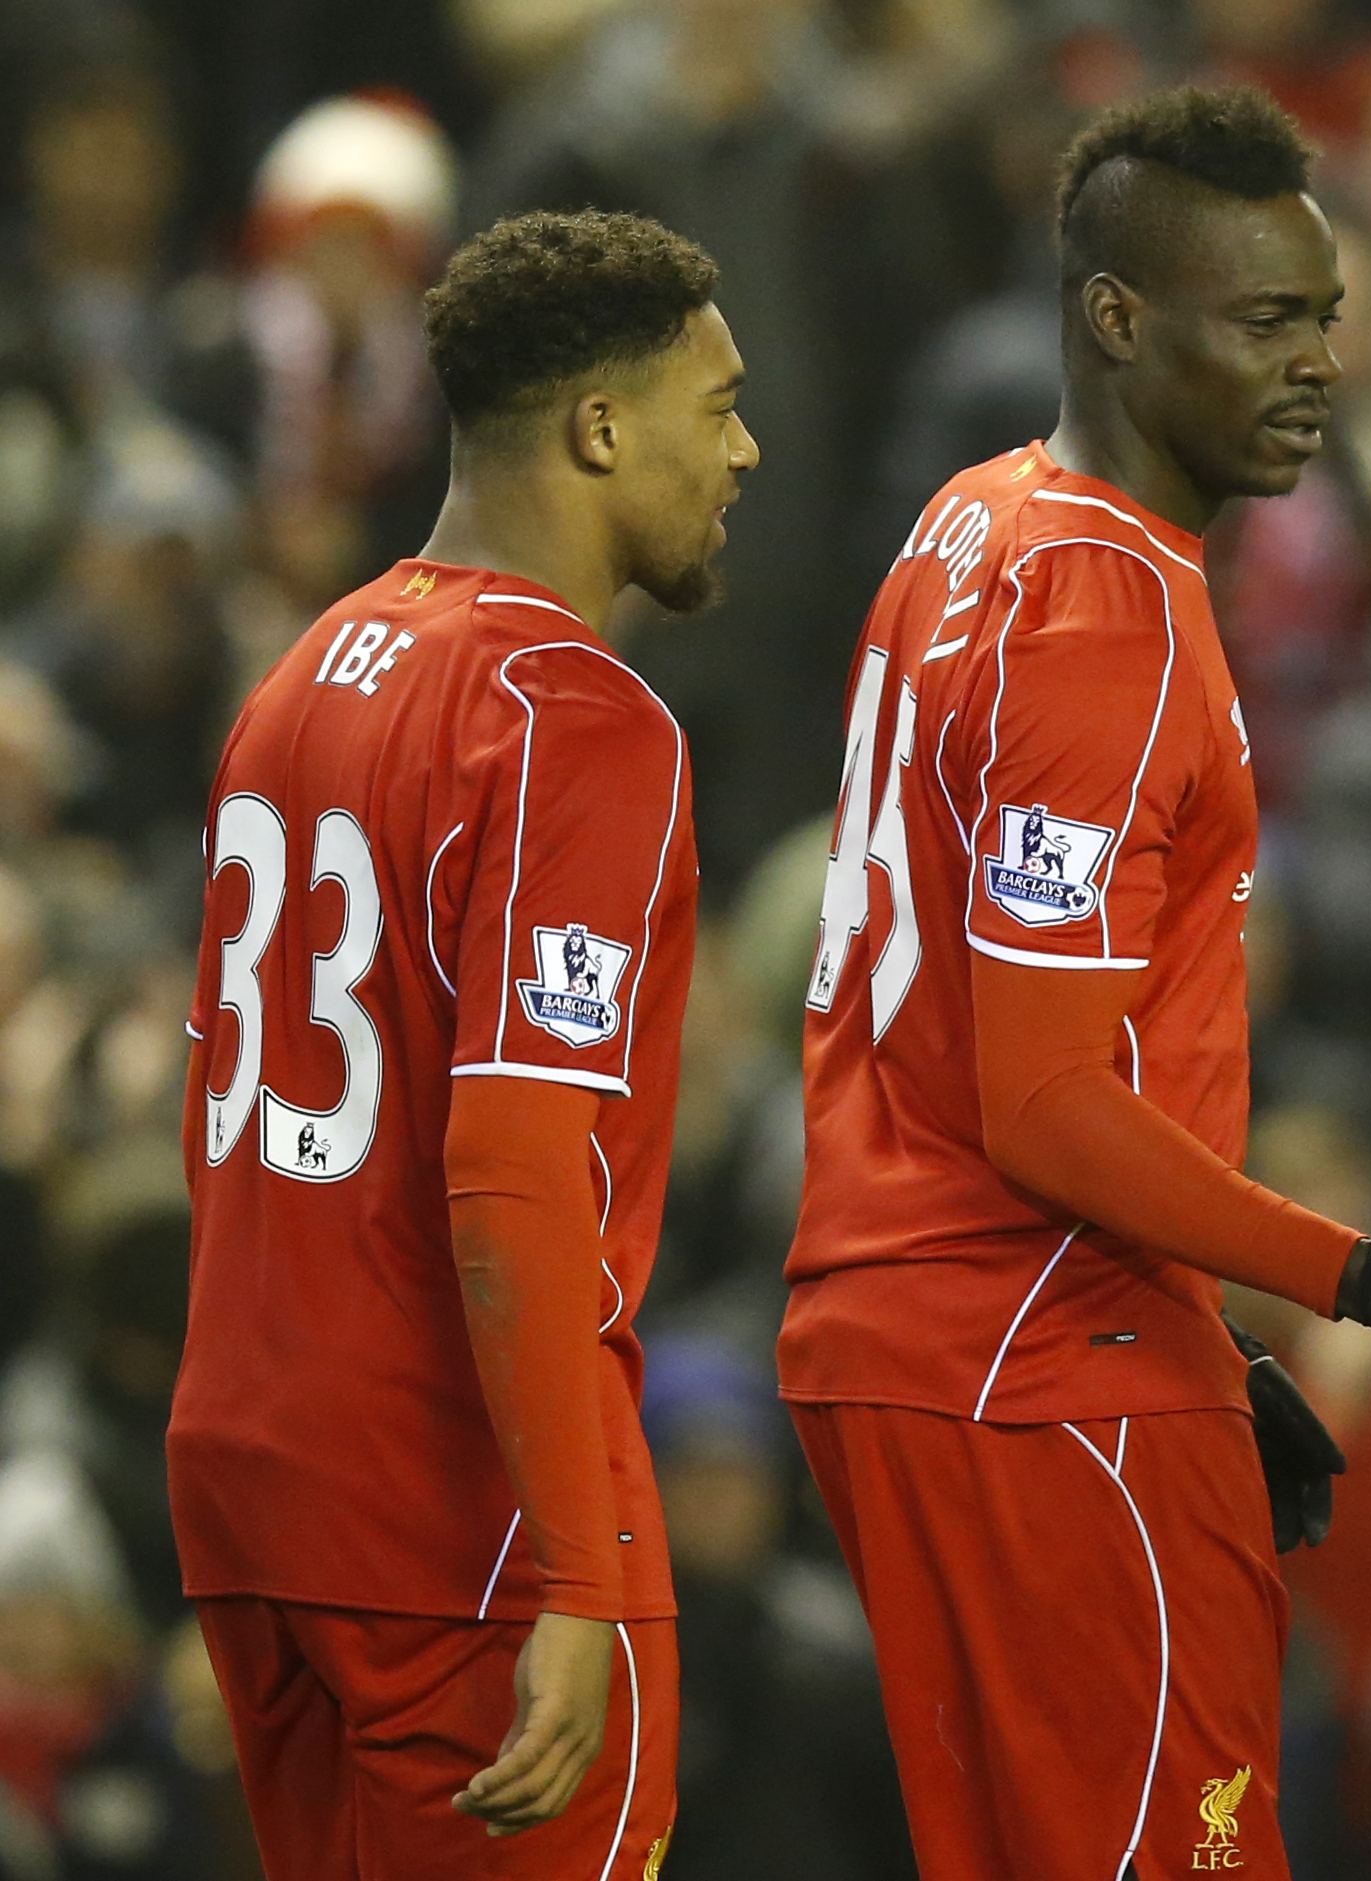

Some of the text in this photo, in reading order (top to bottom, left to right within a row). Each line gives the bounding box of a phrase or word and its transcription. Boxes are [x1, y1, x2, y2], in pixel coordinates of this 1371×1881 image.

[313, 620, 417, 699] IBE
[805, 645, 923, 1046] 45
[995, 883, 1063, 906] PREMIER LEAGUE
[998, 870, 1066, 898] BARCLAYS
[206, 791, 384, 1183] 33
[540, 1006, 576, 1020] PREMIER
[541, 993, 601, 1018] BARCLAYS
